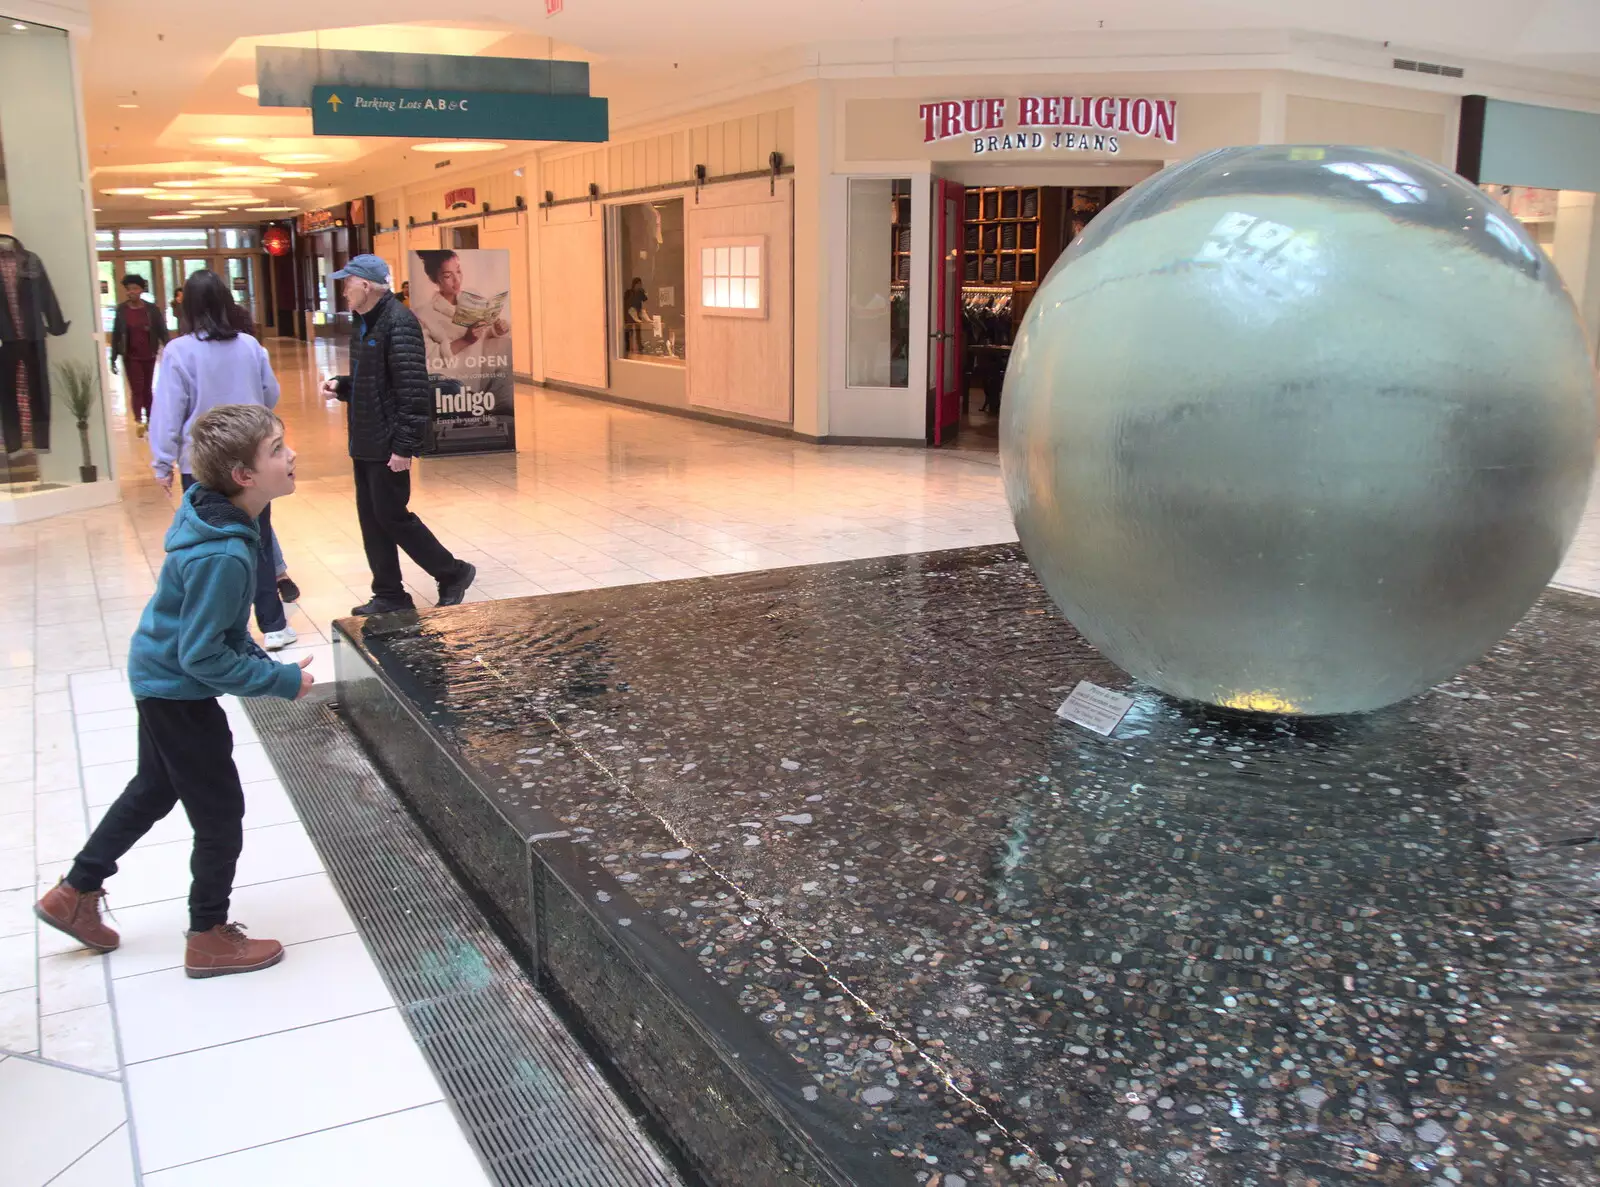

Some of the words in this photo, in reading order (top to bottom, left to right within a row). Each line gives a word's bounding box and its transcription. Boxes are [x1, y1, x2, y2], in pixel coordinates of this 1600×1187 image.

[355, 96, 396, 111] Parking
[399, 98, 422, 110] Lots
[448, 101, 458, 110] &
[459, 100, 468, 111] C
[919, 98, 1005, 143] TRUE
[1017, 96, 1177, 142] RELIGION
[973, 132, 1042, 154] BRAND
[1052, 132, 1118, 154] JEANS
[427, 357, 459, 370] OW
[465, 355, 508, 368] OPEN
